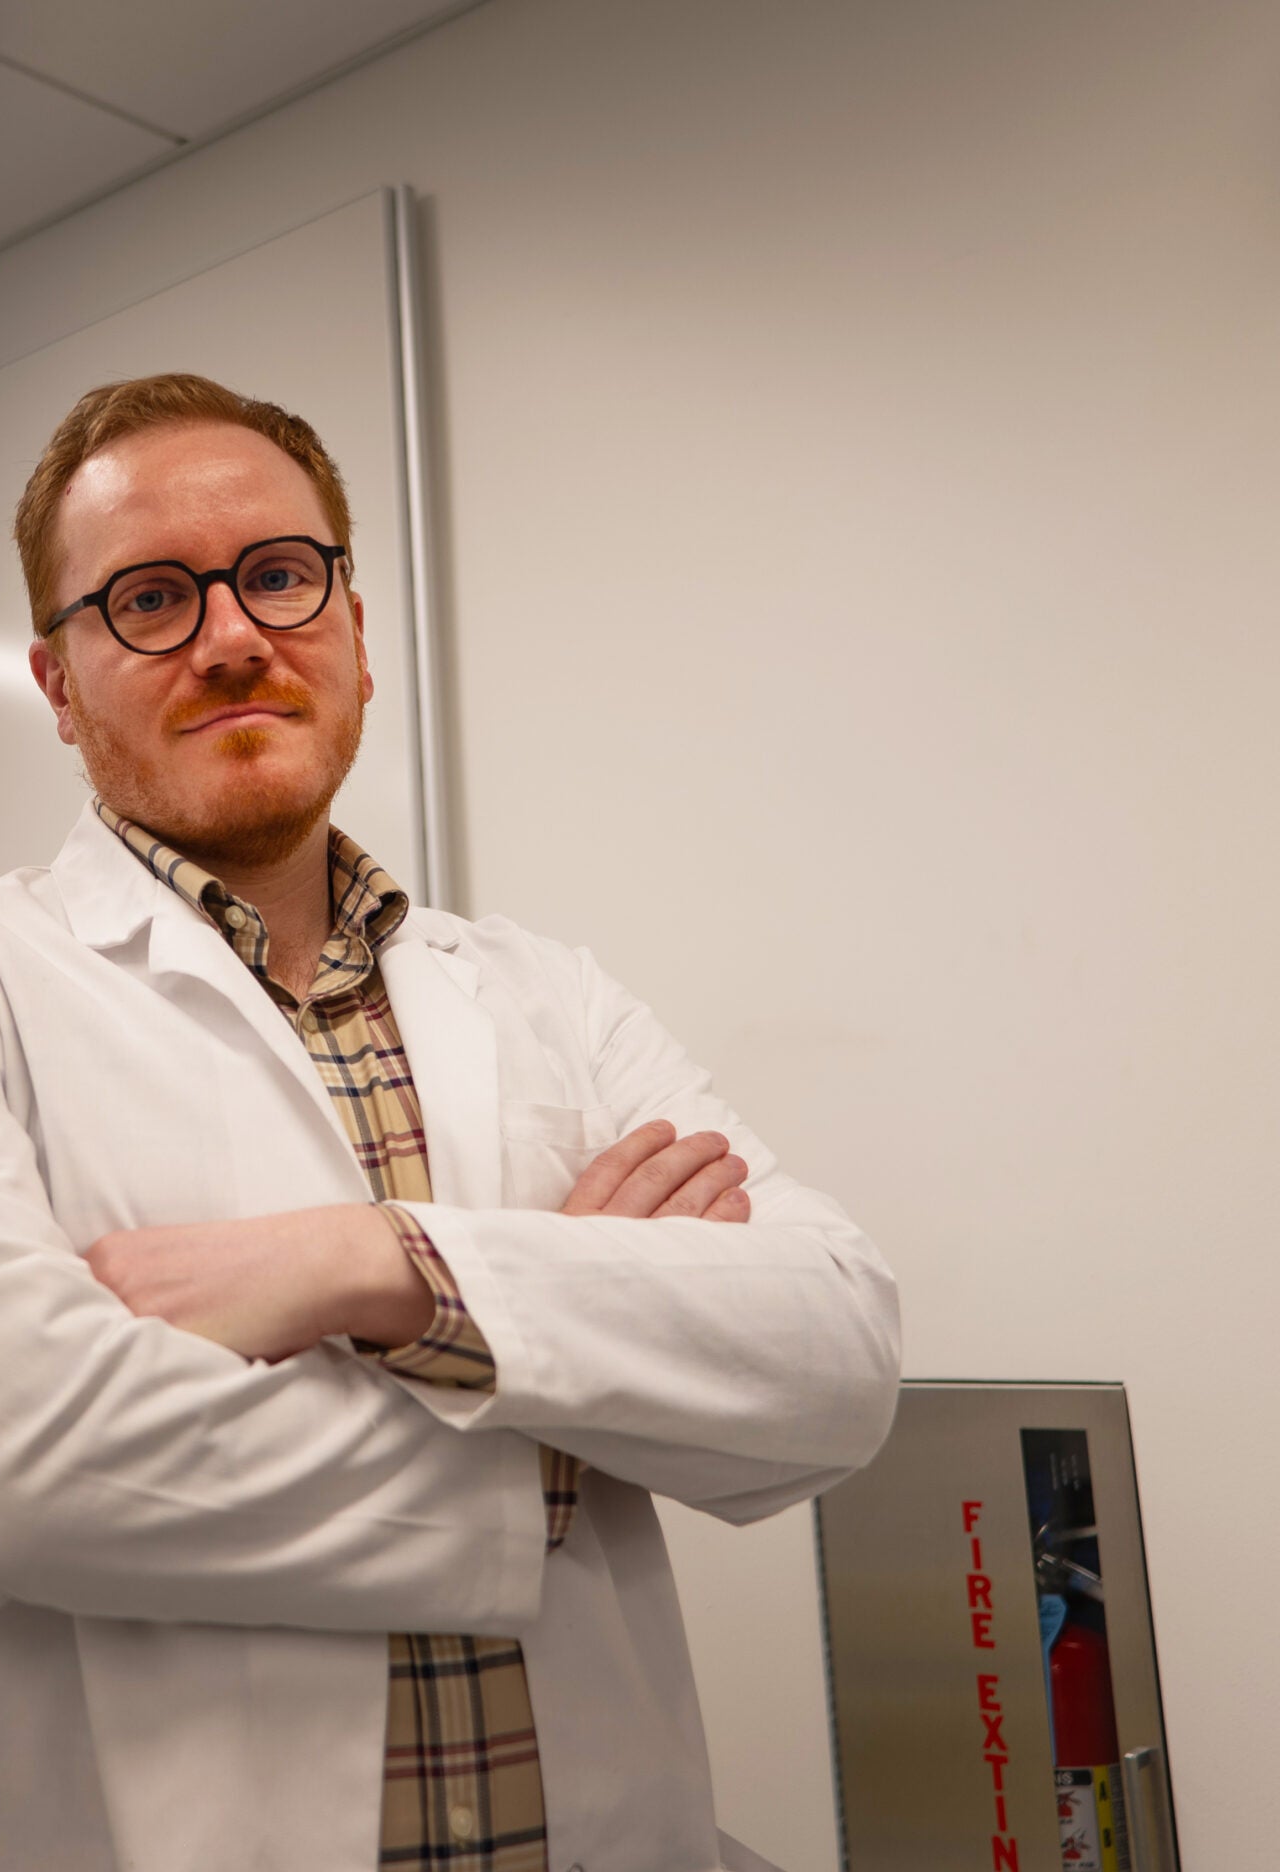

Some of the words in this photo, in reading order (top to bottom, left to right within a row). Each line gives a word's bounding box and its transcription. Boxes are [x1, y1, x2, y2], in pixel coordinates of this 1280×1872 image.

[962, 1500, 996, 1649] FIRE
[977, 1673, 1019, 1872] EXTIN
[1099, 1780, 1110, 1801] A
